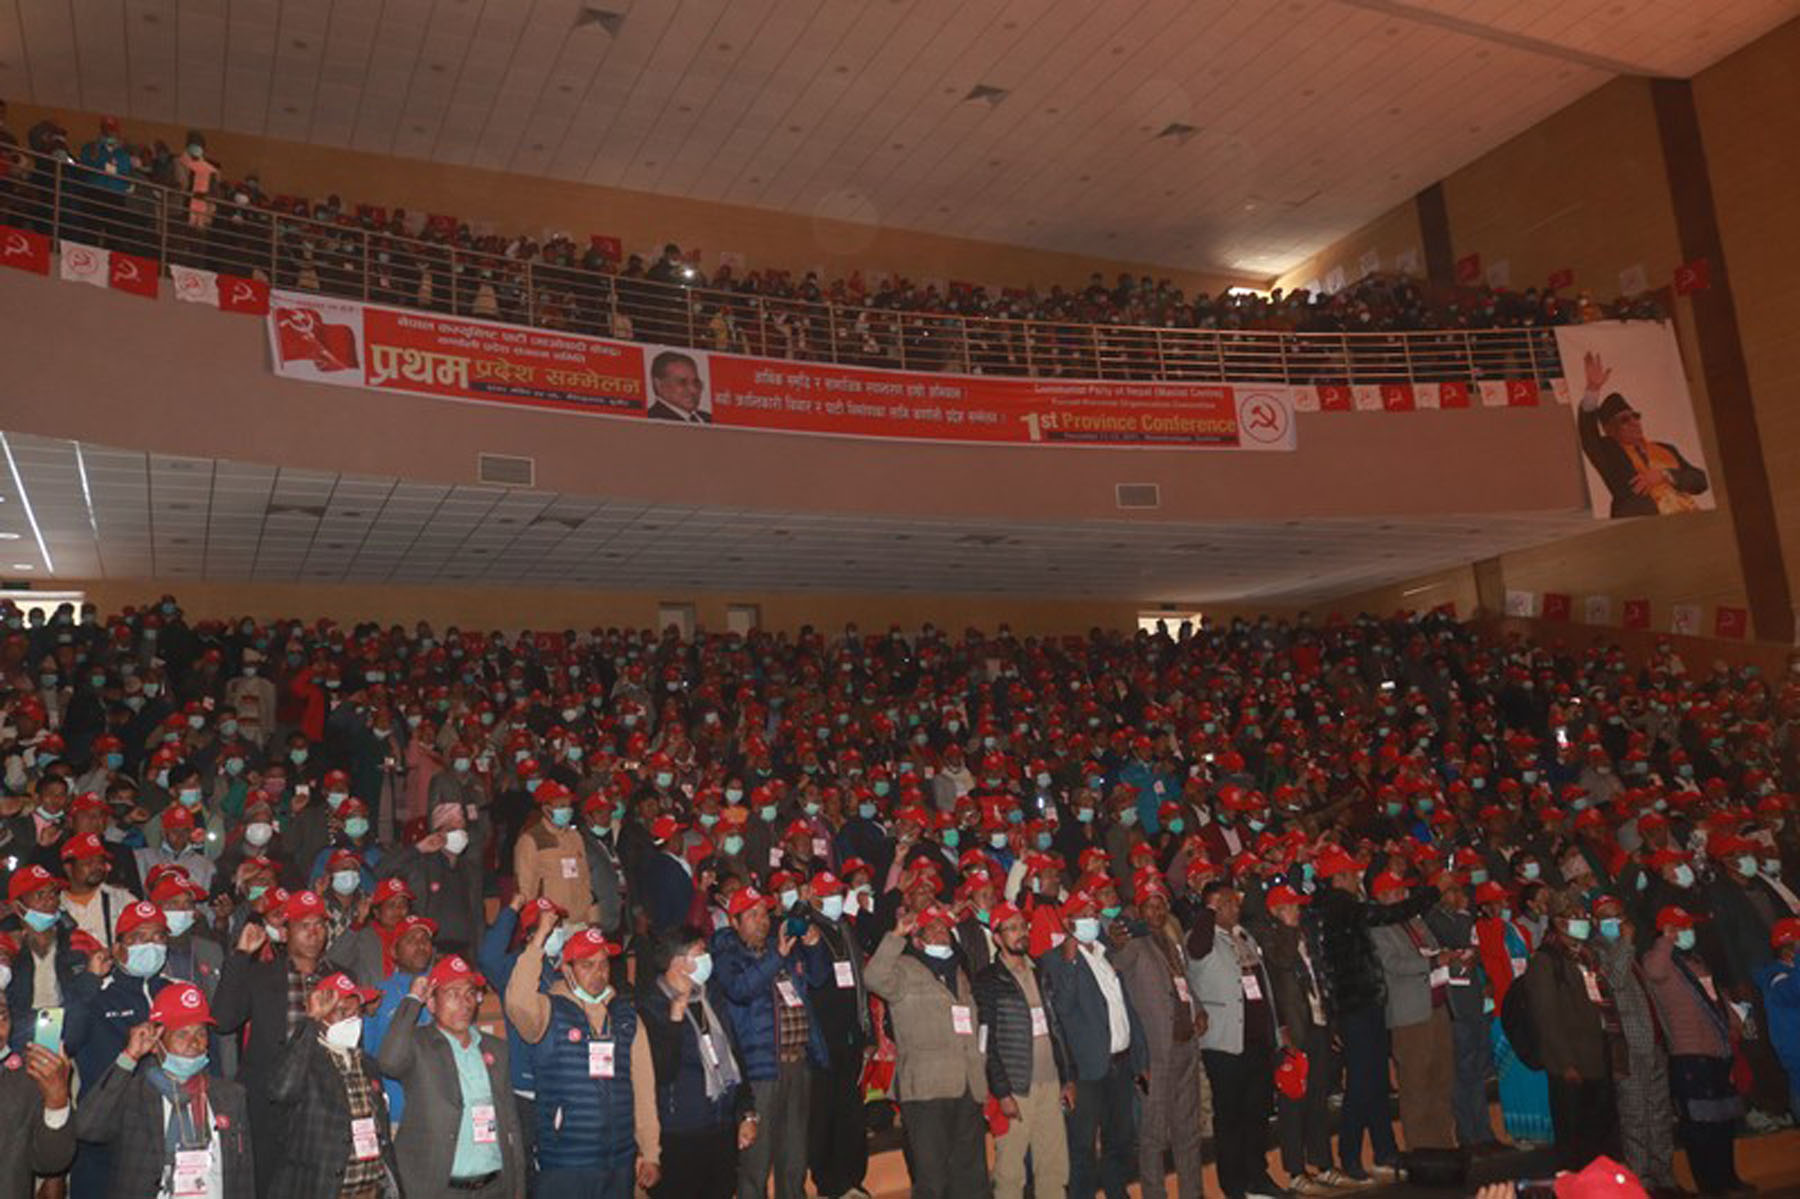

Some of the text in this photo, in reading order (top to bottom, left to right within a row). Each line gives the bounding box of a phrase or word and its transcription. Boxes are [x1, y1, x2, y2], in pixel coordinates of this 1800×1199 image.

[369, 344, 641, 395] प्रथम प्रदेश सम्मेलन
[1020, 411, 1059, 441] 1st
[1062, 411, 1136, 431] Province
[1140, 413, 1237, 434] Conference
